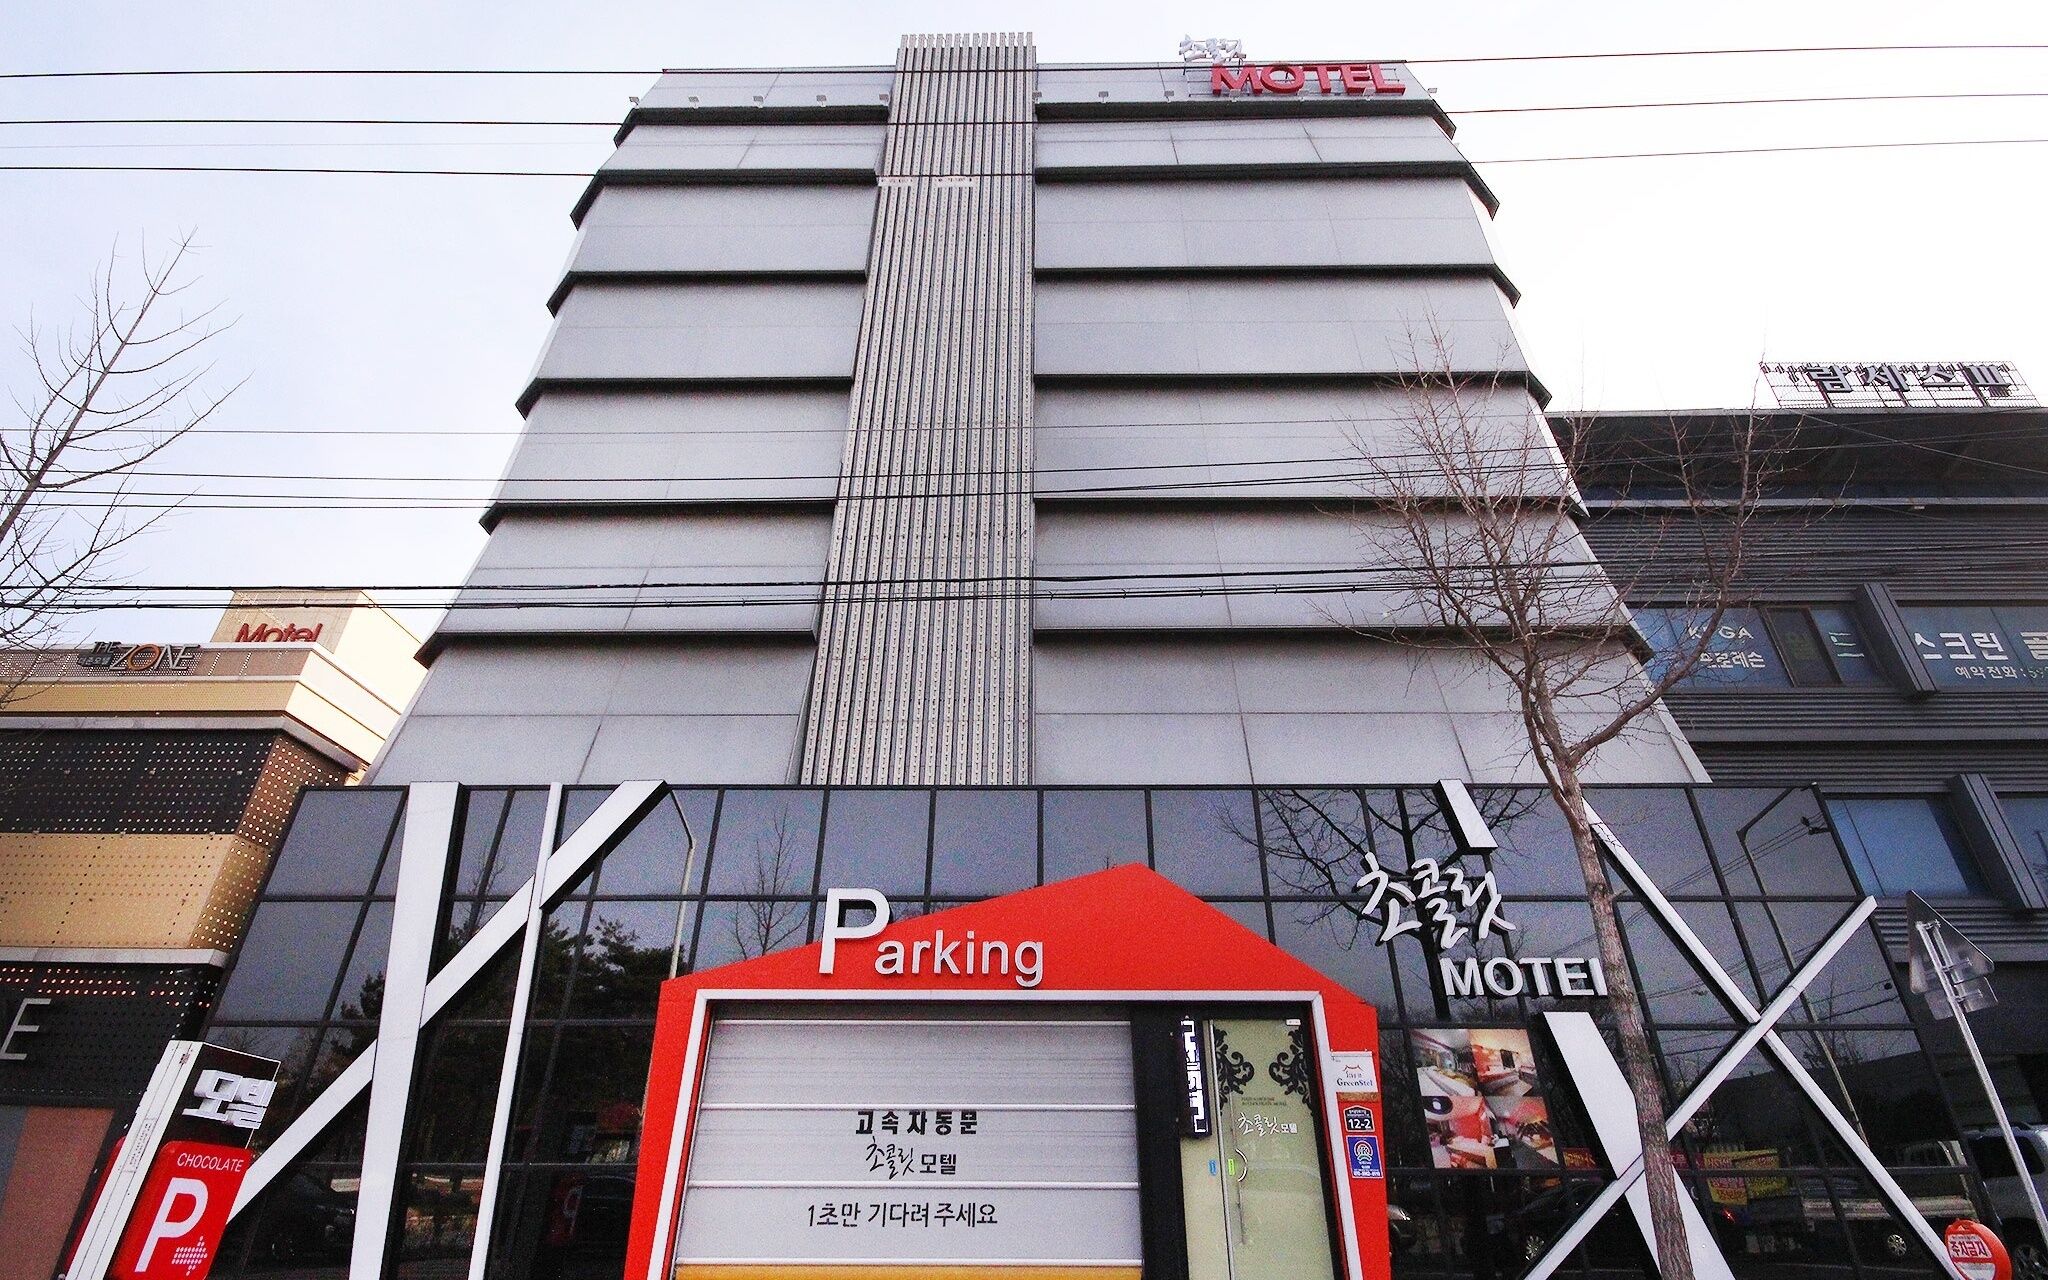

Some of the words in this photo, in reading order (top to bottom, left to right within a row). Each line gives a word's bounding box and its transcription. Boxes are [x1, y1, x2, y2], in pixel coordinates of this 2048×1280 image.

[1211, 63, 1406, 95] MOTEL
[109, 644, 201, 671] ZONE
[1914, 632, 2009, 660] 스크린
[1356, 851, 1516, 949] 초콜릿
[819, 888, 1044, 987] Parking
[182, 1069, 277, 1130] 모텔
[1348, 1118, 1372, 1129] 12-2
[176, 1152, 245, 1172] CHOCOLATE
[866, 1136, 914, 1180] 초콜릿
[920, 1153, 957, 1175] 모텔
[134, 1177, 209, 1272] P
[807, 1202, 861, 1228] 1초만
[867, 1202, 929, 1228] 기다려
[934, 1202, 998, 1228] 주세요
[1949, 1240, 1988, 1257] 주차금지
